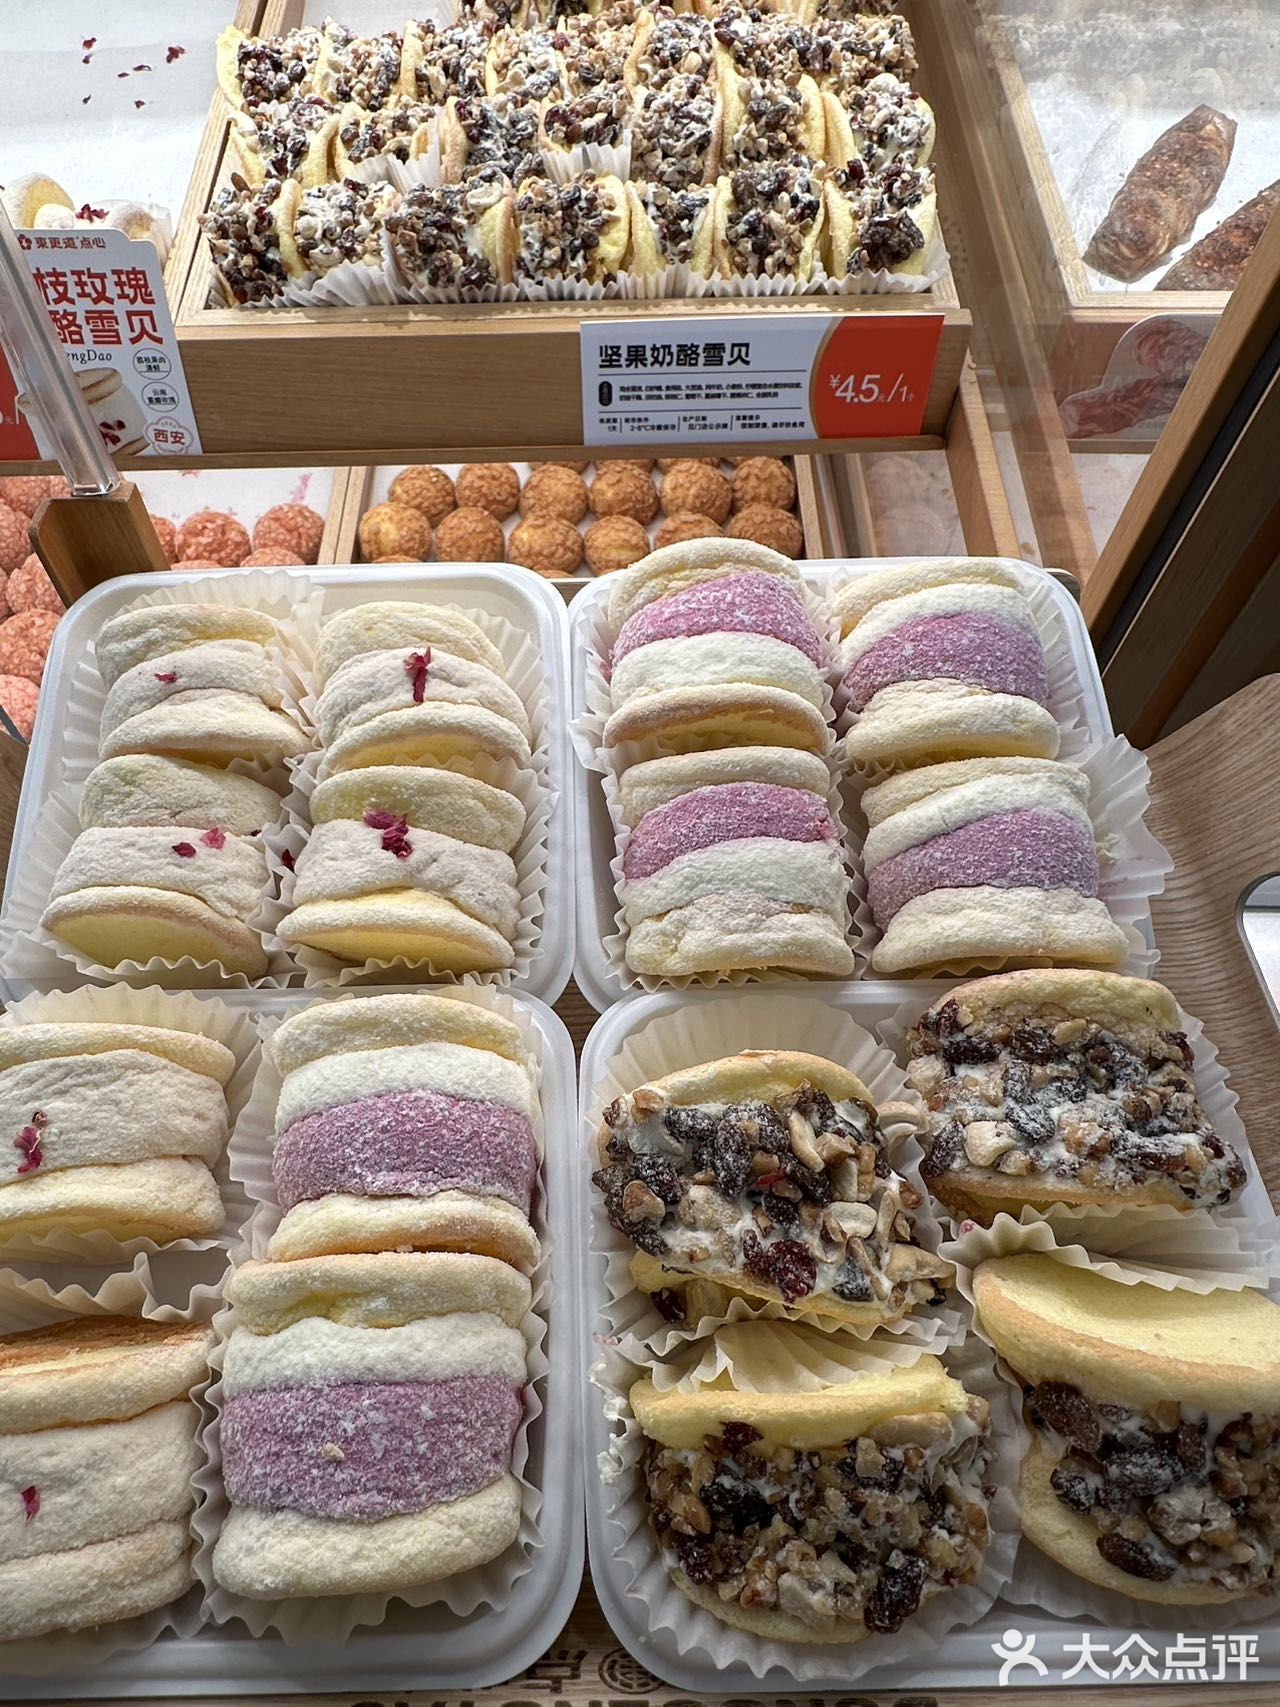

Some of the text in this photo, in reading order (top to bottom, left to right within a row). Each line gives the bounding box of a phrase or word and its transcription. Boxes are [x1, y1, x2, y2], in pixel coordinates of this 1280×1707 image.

[598, 341, 752, 369] 坚果奶酪雪贝
[153, 428, 186, 446] 西安
